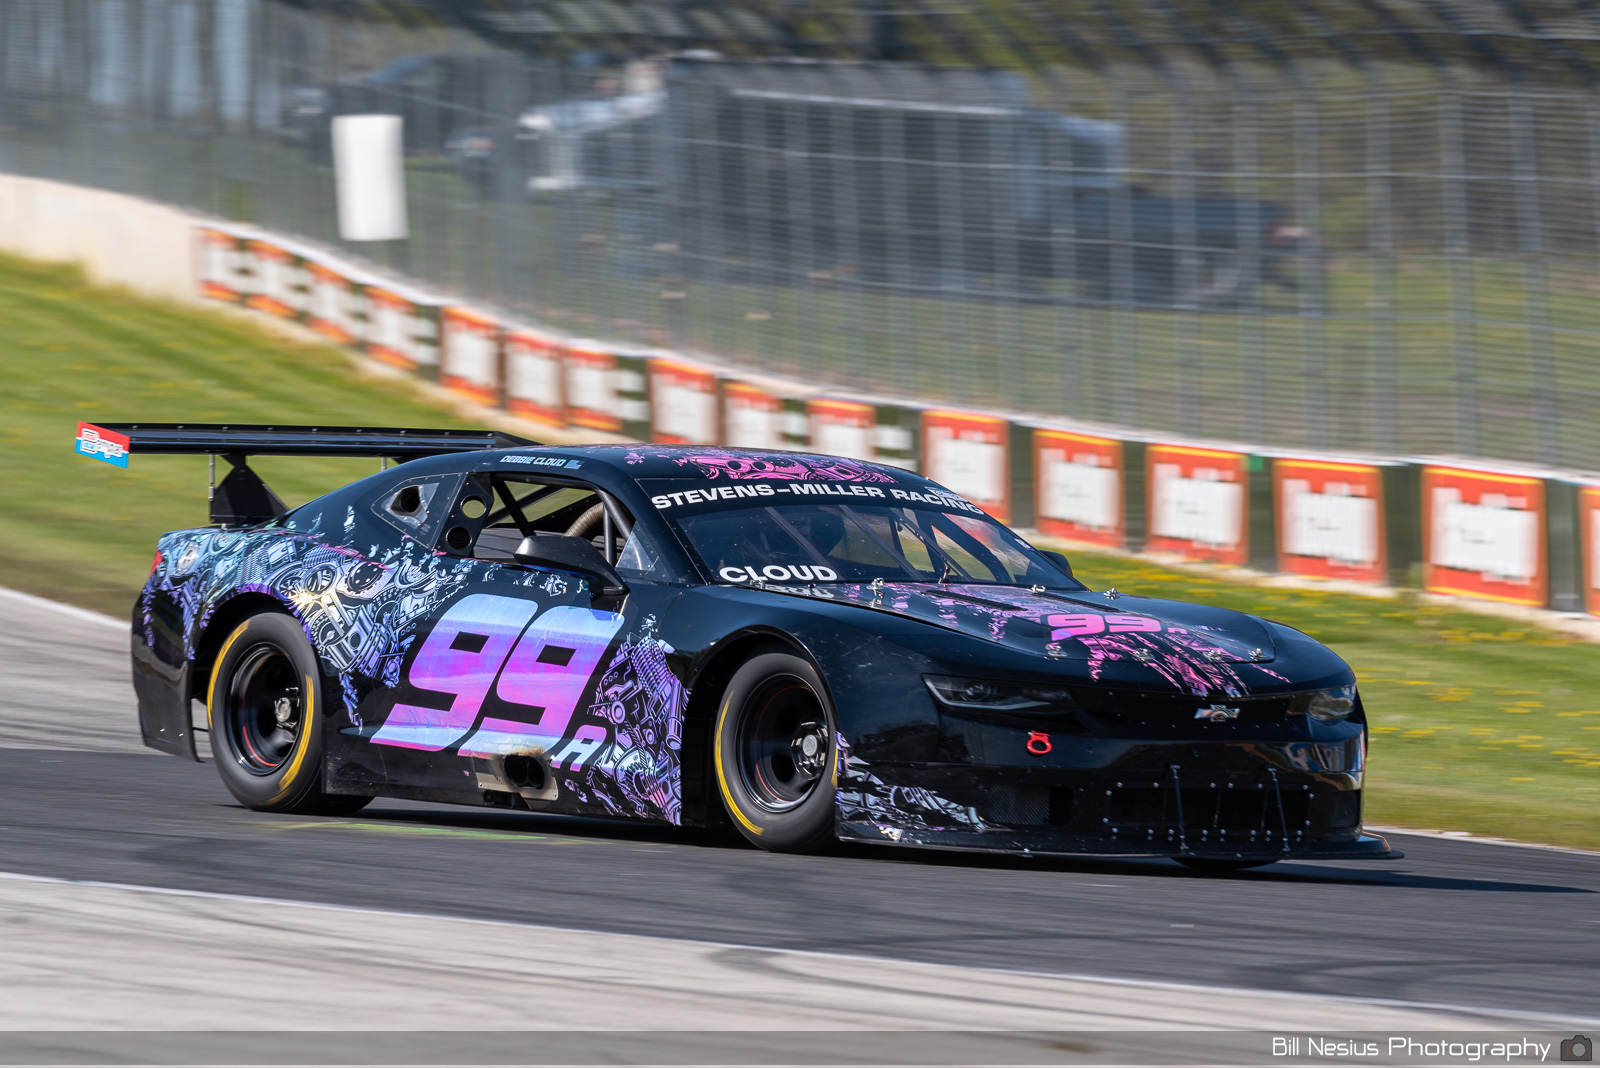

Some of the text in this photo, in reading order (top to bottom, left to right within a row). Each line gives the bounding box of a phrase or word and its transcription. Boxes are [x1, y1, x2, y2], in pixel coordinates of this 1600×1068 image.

[500, 455, 567, 467] DEBBIE CLOUD
[651, 483, 886, 509] STEVENS-MILLER
[890, 488, 985, 515] RACING
[719, 565, 838, 582] CLOUD
[1047, 613, 1162, 641] 99
[370, 593, 625, 772] 99 A
